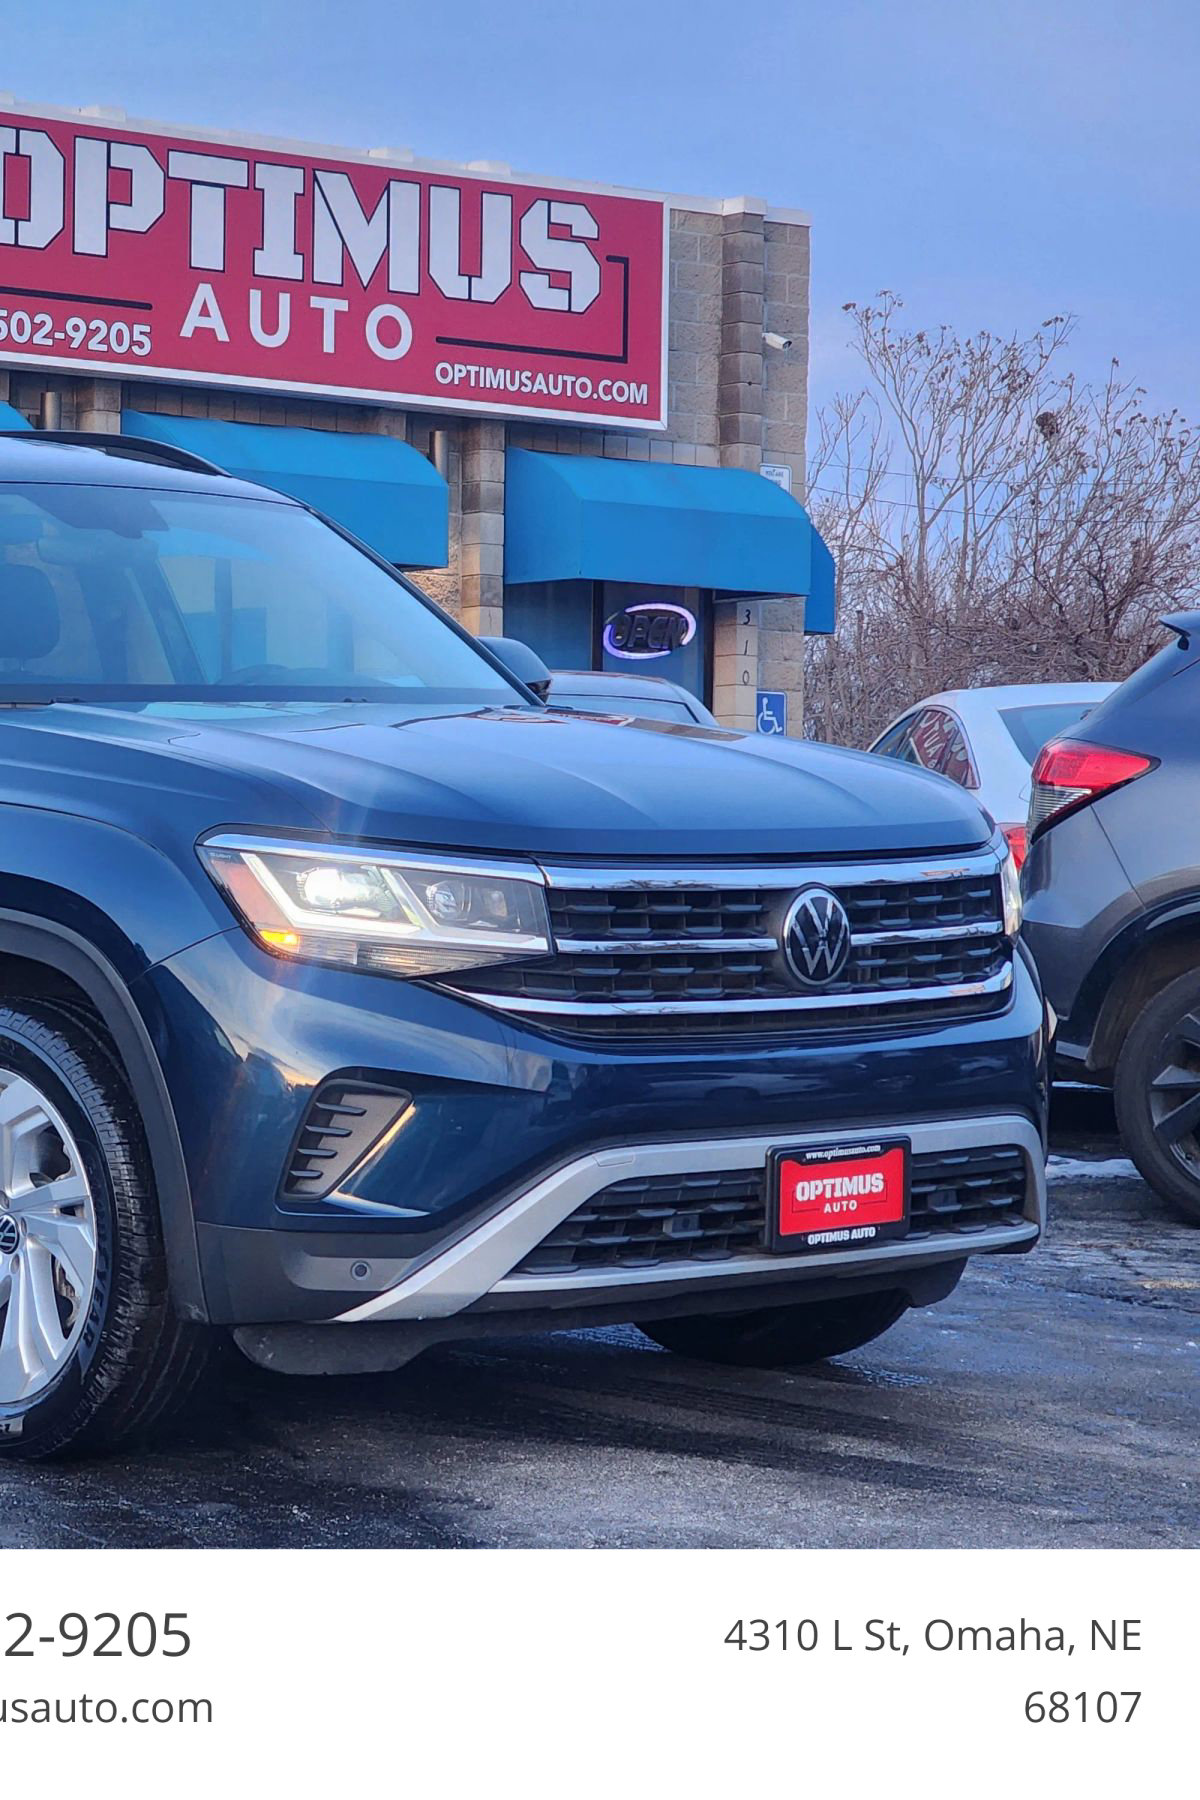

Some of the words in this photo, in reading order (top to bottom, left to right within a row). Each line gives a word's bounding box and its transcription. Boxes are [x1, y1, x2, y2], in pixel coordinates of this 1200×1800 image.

[179, 283, 414, 361] AUTO
[435, 361, 649, 406] OPTIMUSAUTO.COM
[610, 613, 688, 651] OPEN
[795, 1173, 884, 1202] OPTIMUS
[824, 1200, 858, 1213] AUTO
[807, 1229, 850, 1245] OPTIMUS
[851, 1226, 876, 1239] AUTO
